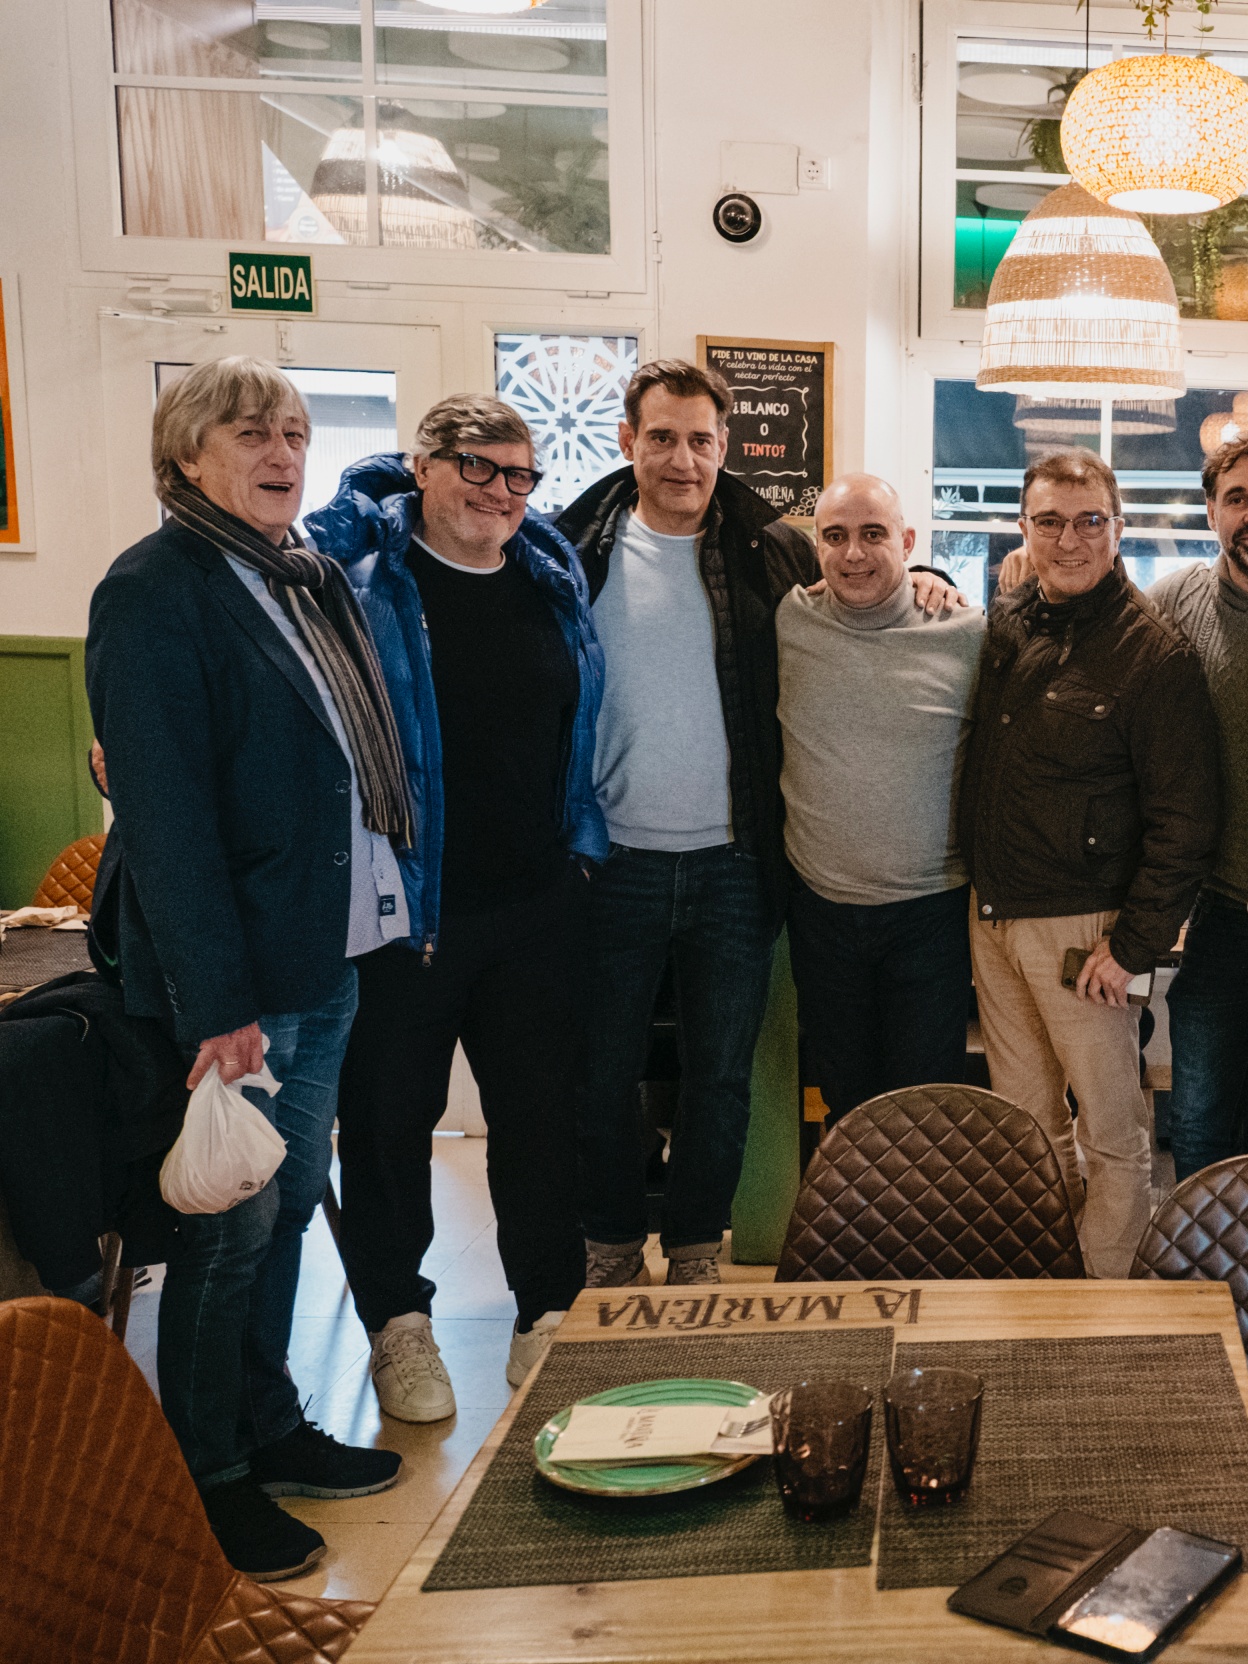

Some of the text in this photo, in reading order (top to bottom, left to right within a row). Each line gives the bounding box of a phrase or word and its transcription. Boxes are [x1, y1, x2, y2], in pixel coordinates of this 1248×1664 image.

[232, 264, 310, 301] SALIDA
[712, 350, 818, 364] PIDE TU VINO DE LA CASA
[719, 360, 813, 373] Y celebra la vida con el
[761, 372, 797, 382] perfecto
[733, 401, 789, 416] ¿BLANCO
[759, 423, 769, 436] O
[742, 443, 786, 458] TINTO?
[597, 1286, 923, 1331] LA MARTEÑA
